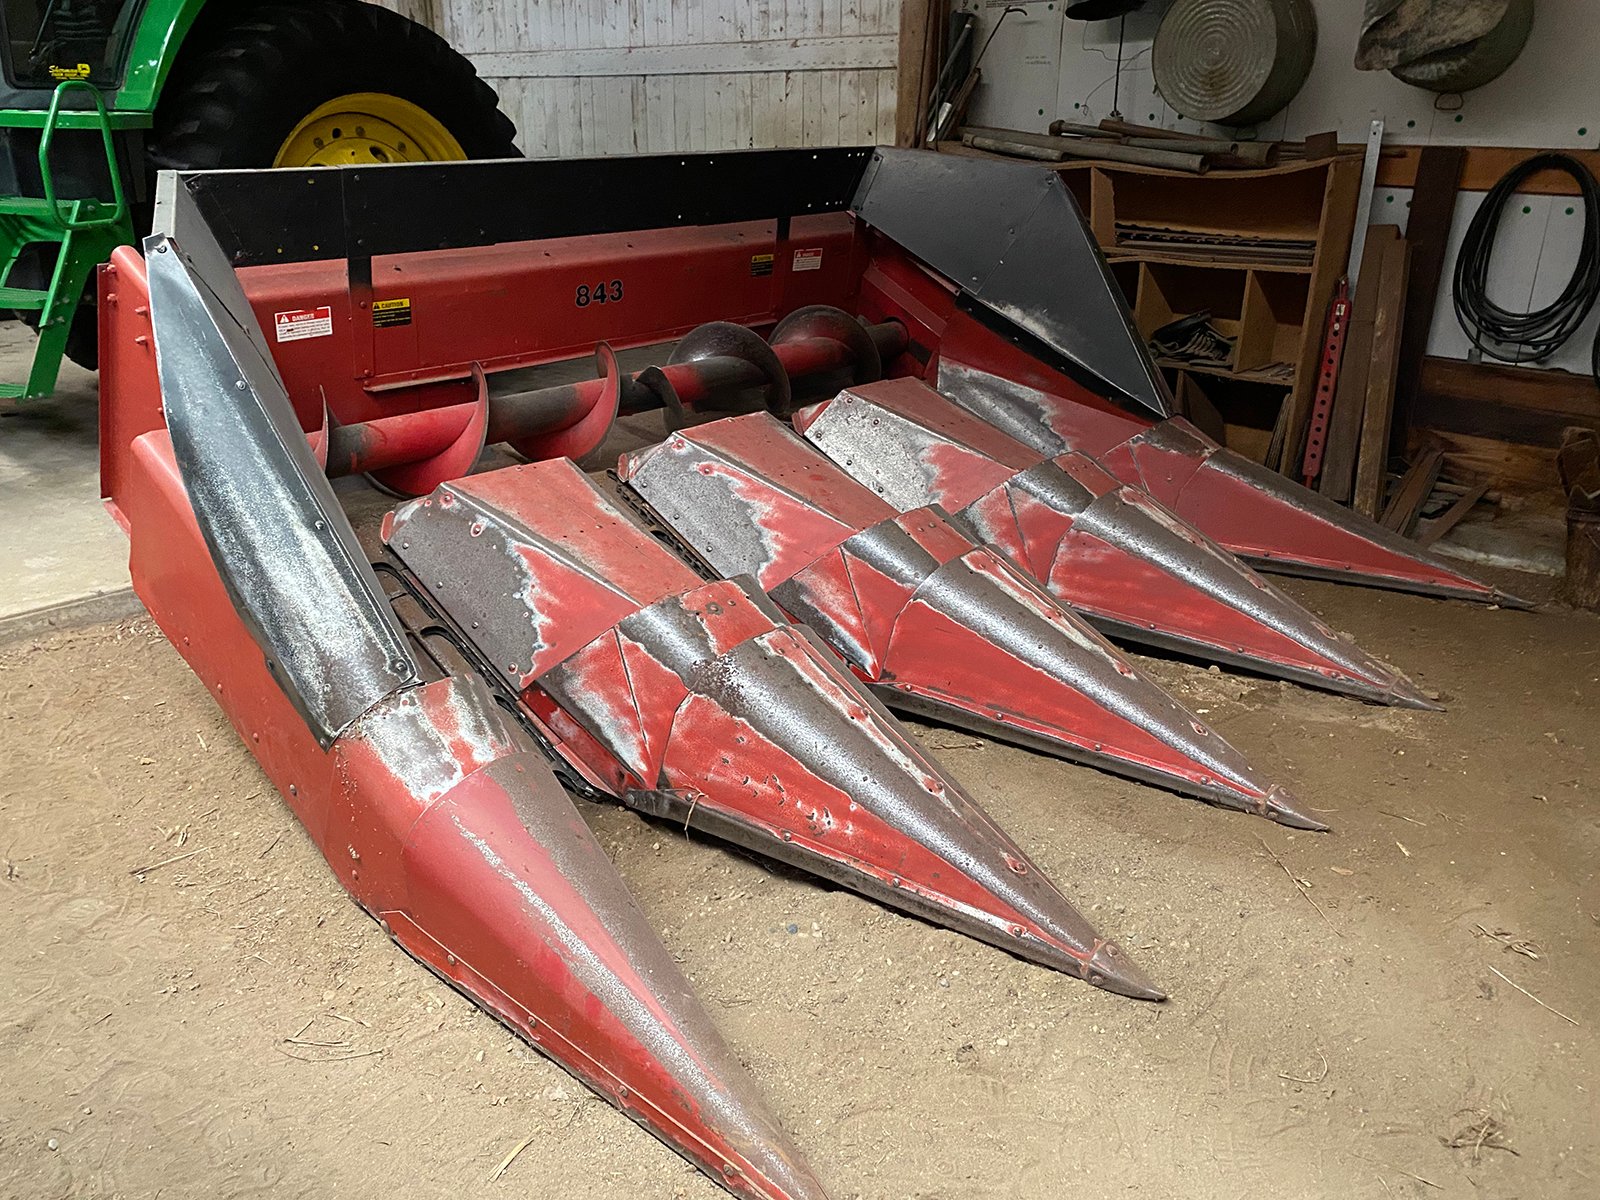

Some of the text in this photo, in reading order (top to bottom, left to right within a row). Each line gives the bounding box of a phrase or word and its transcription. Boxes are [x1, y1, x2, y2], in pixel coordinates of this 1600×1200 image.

[575, 279, 624, 308] 843
[381, 301, 404, 309] CAUTION
[291, 313, 315, 322] DANGER
